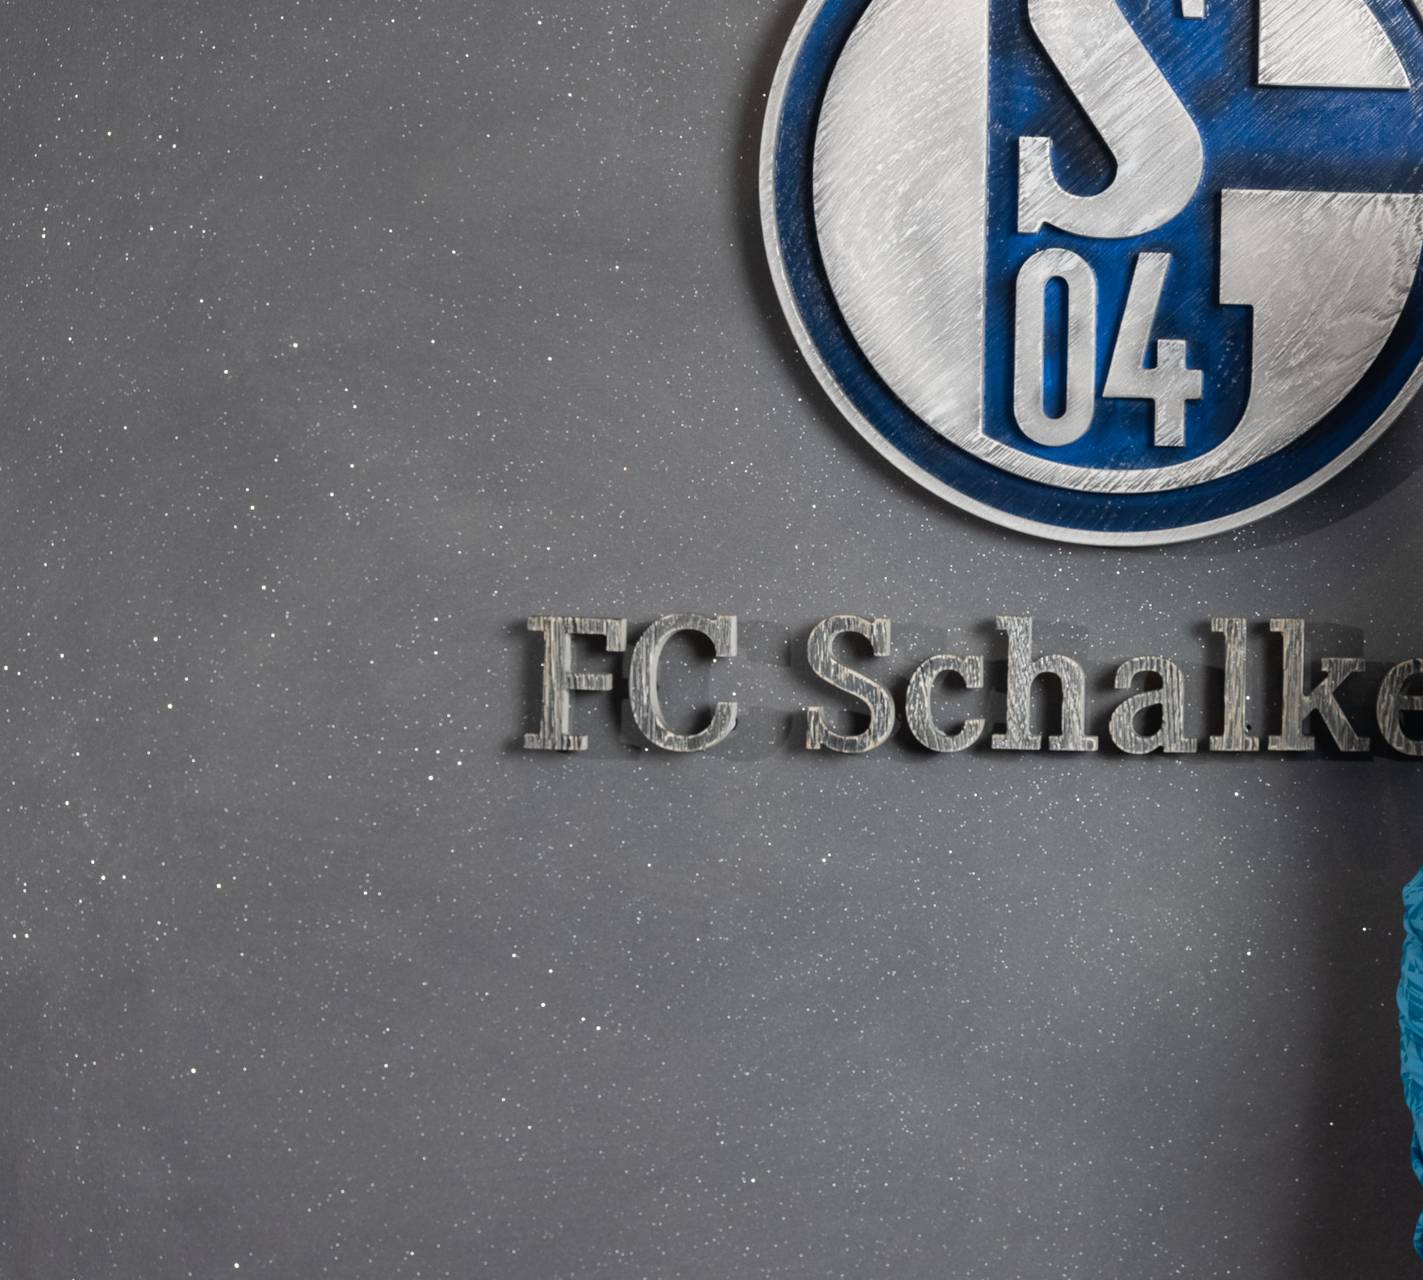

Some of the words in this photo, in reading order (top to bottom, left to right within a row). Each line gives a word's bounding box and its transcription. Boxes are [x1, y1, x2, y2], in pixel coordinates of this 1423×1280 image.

[1018, 0, 1206, 239] S
[1013, 247, 1202, 447] 04
[523, 612, 738, 752] FC
